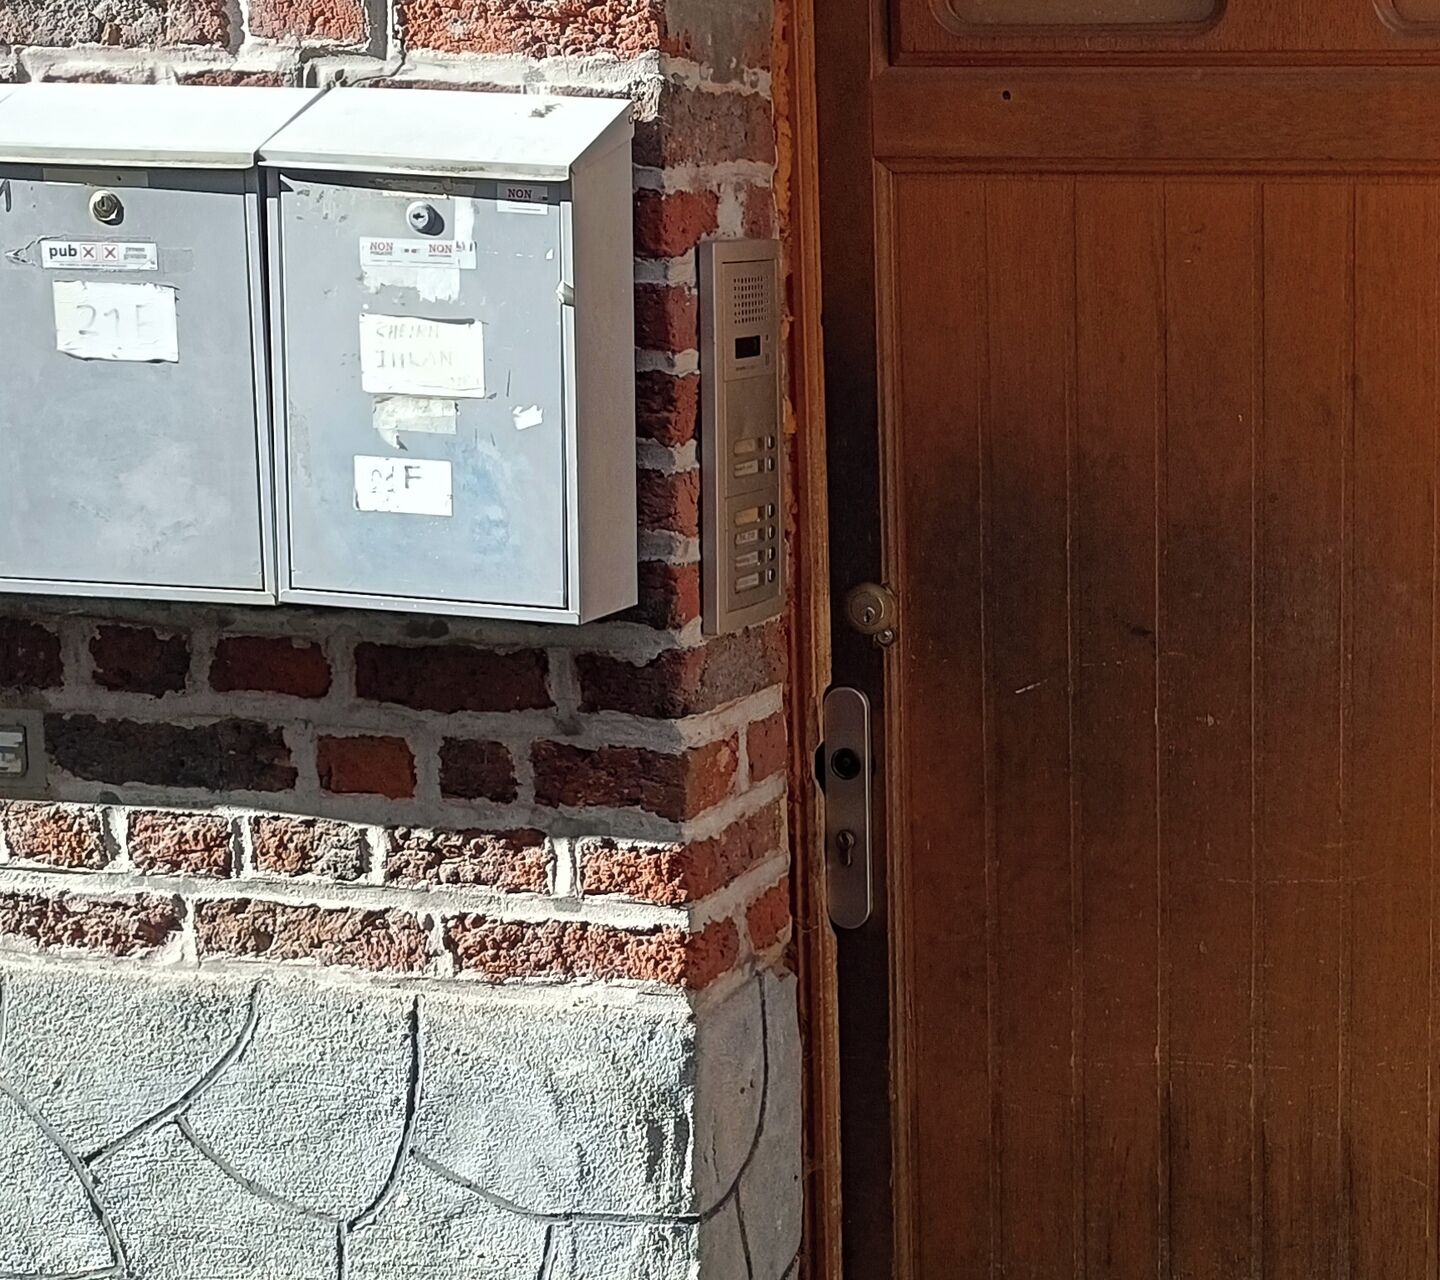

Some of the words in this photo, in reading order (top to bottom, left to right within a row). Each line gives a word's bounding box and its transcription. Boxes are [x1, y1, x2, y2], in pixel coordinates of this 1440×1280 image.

[508, 188, 533, 199] NON
[49, 244, 78, 259] pub
[370, 242, 394, 251] NON
[428, 243, 453, 254] NON
